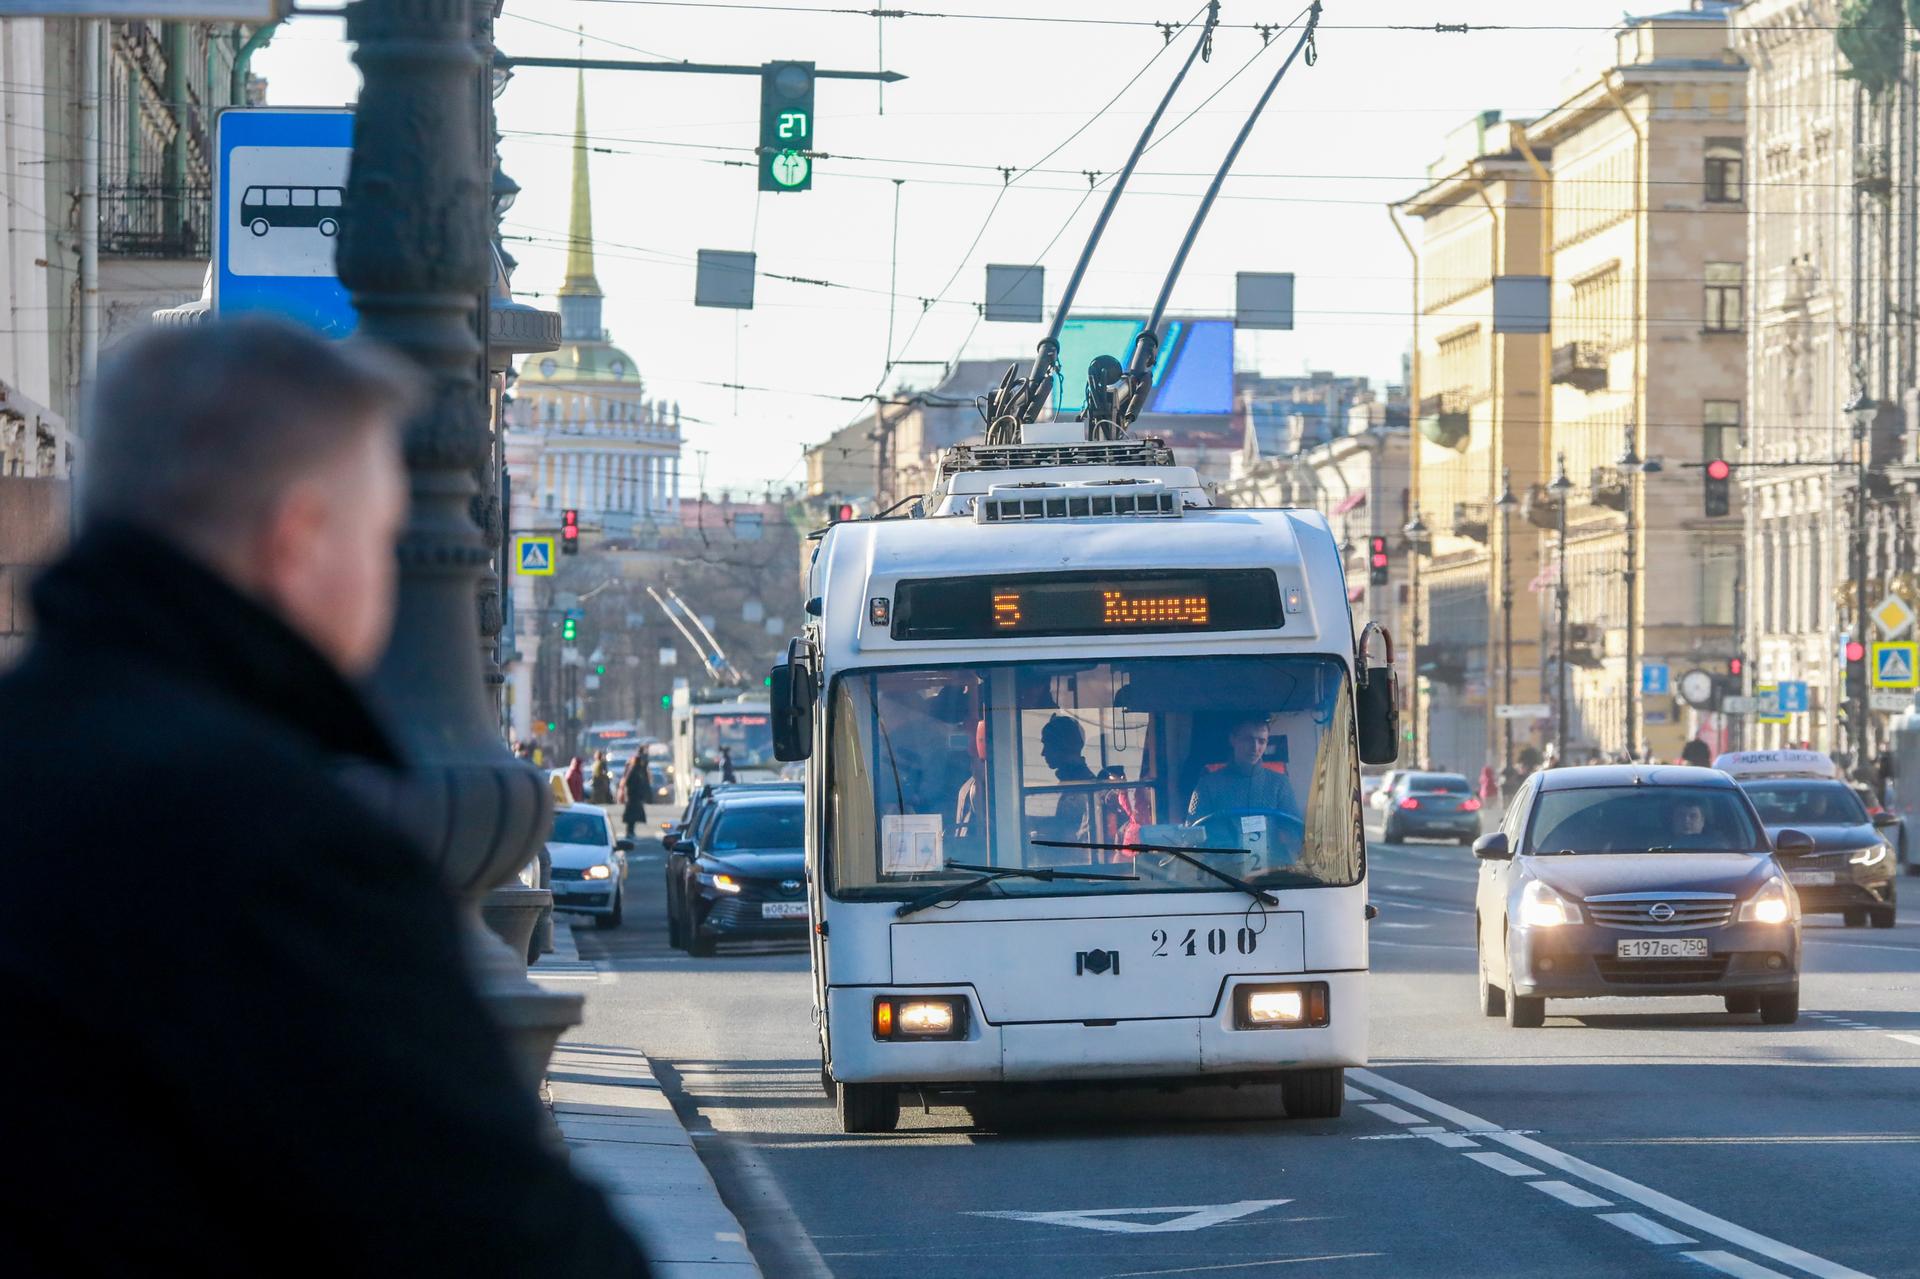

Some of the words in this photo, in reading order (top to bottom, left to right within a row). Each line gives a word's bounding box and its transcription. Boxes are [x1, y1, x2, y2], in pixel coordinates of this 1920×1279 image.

[779, 112, 807, 138] 27
[994, 594, 1020, 625] 5
[1732, 752, 1778, 763] Яндекс
[1151, 928, 1257, 957] 2400
